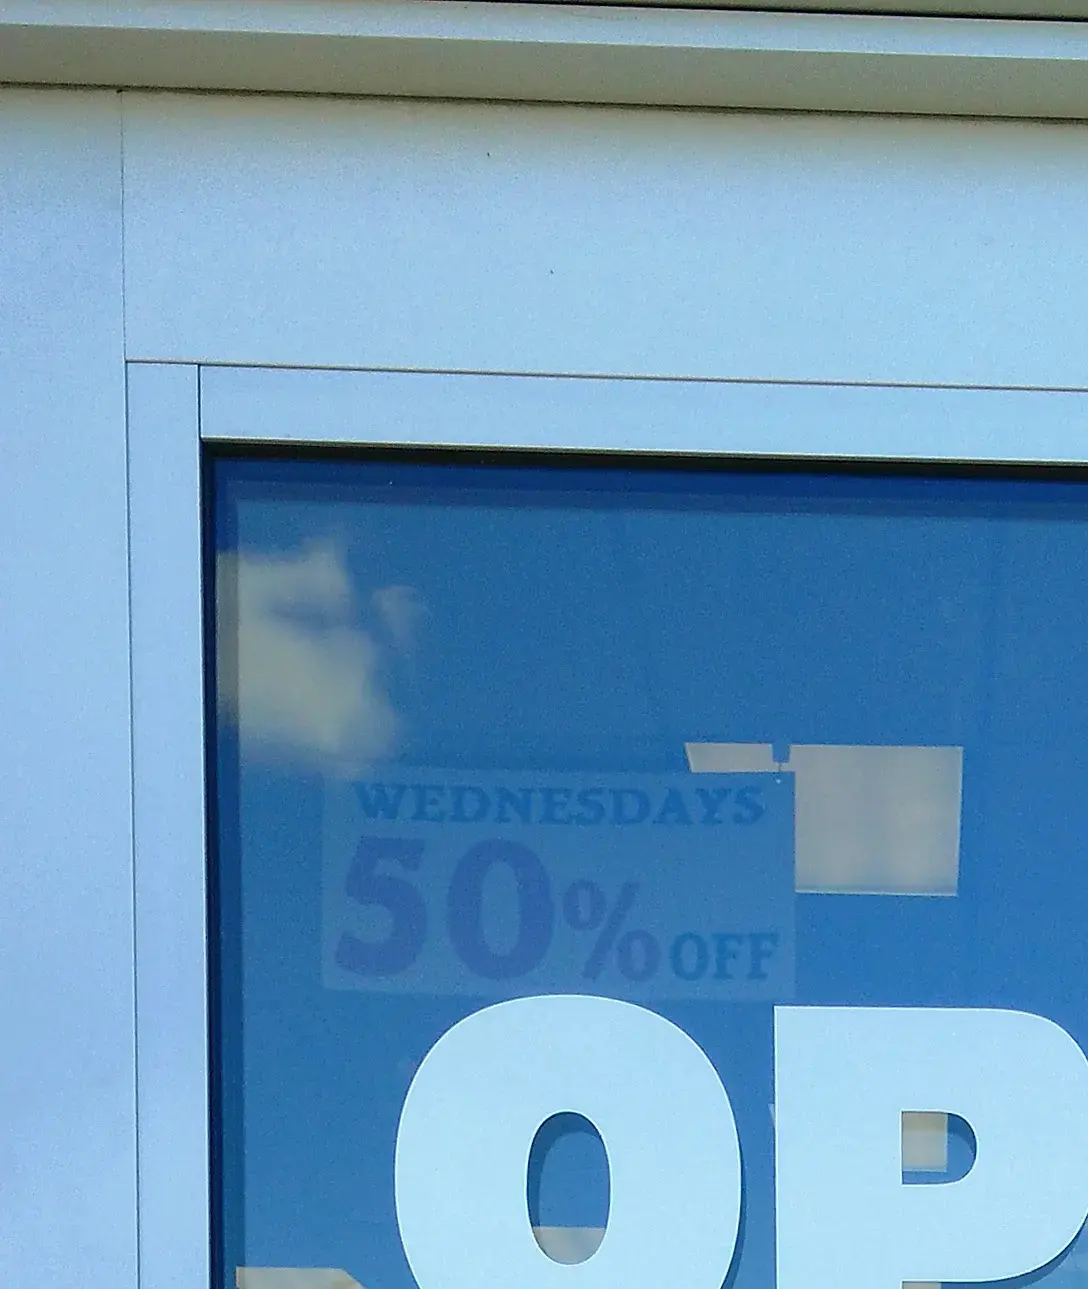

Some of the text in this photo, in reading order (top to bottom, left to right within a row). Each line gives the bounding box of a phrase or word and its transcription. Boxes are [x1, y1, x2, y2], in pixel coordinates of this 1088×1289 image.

[353, 783, 763, 825] WEDNESDAYS
[334, 836, 779, 981] 50% OFF
